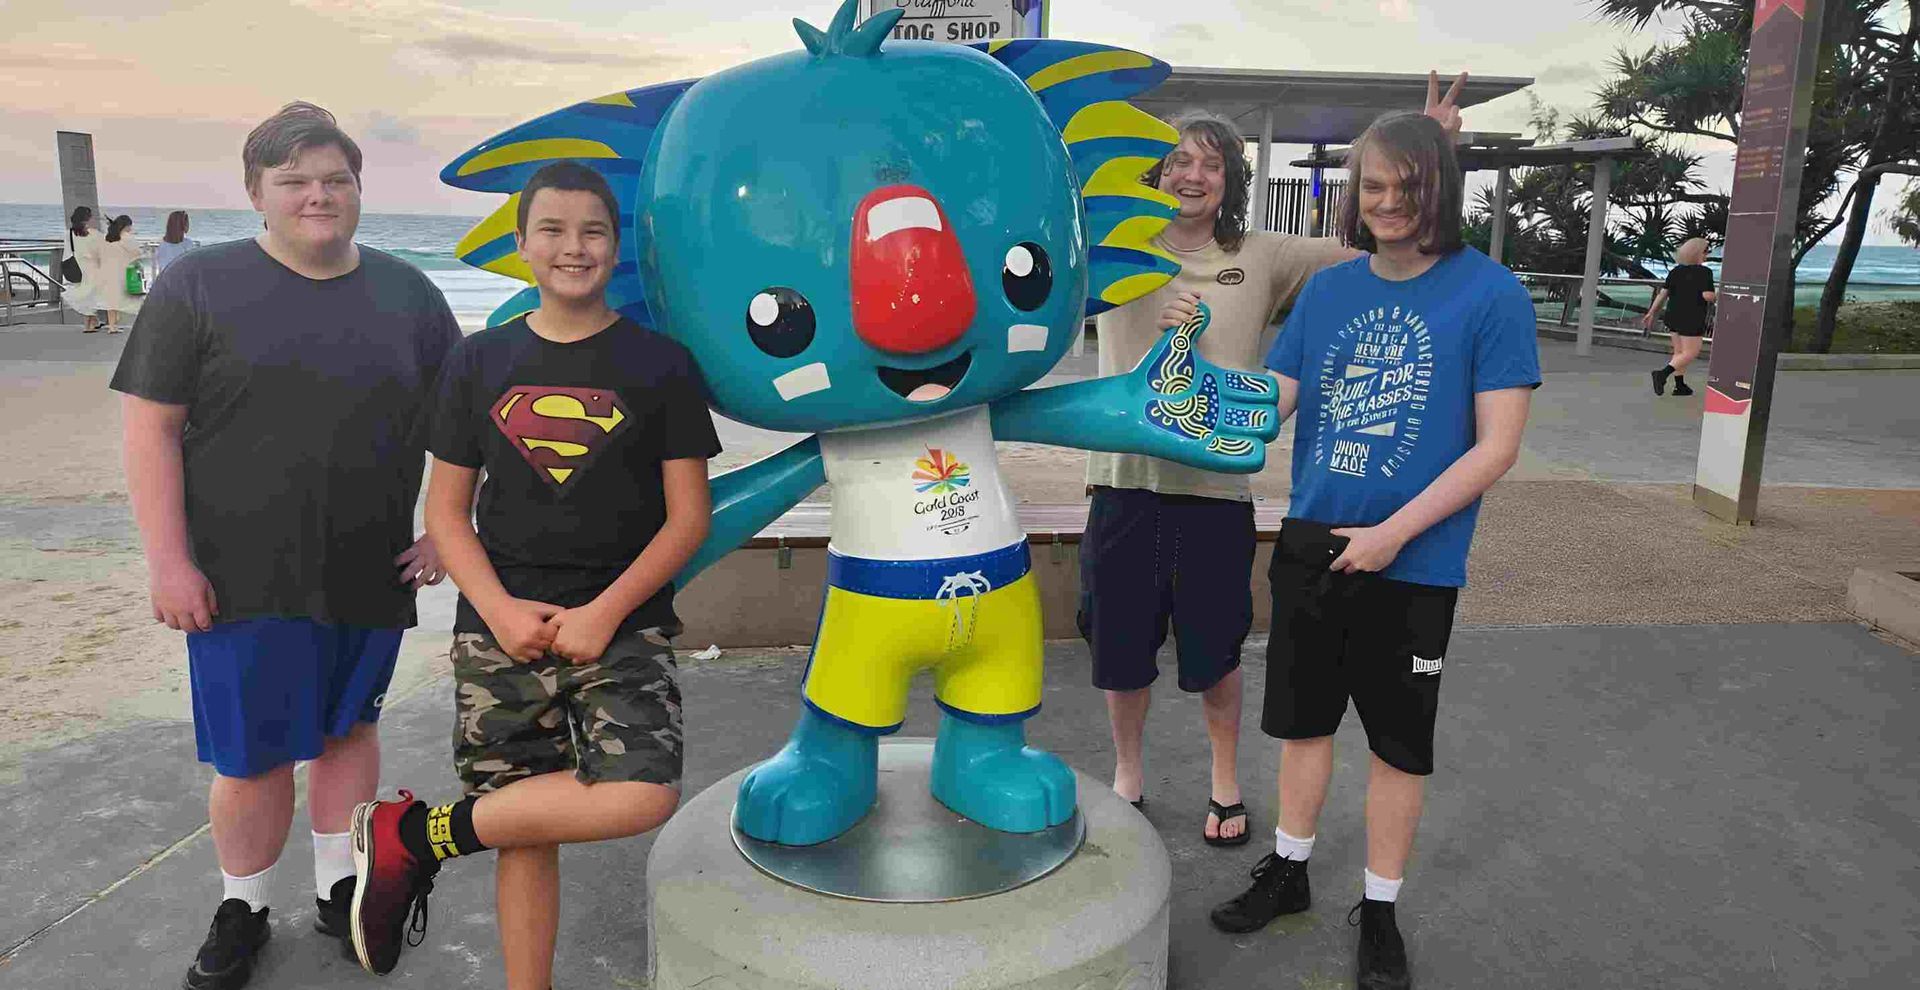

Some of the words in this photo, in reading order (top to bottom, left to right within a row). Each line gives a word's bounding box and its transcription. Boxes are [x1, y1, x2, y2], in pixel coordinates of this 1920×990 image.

[893, 23, 935, 40] TOG
[946, 21, 1000, 41] SHOP
[1354, 343, 1381, 357] NEW
[1332, 376, 1378, 402] BUILT
[1380, 363, 1414, 390] FOR
[1355, 385, 1413, 415] MASSES
[1333, 439, 1370, 459] UNION
[1381, 417, 1423, 478] DIVISION
[1329, 453, 1368, 474] MADE
[914, 495, 947, 515] Gold
[949, 489, 980, 506] Coast
[940, 505, 965, 521] 2018
